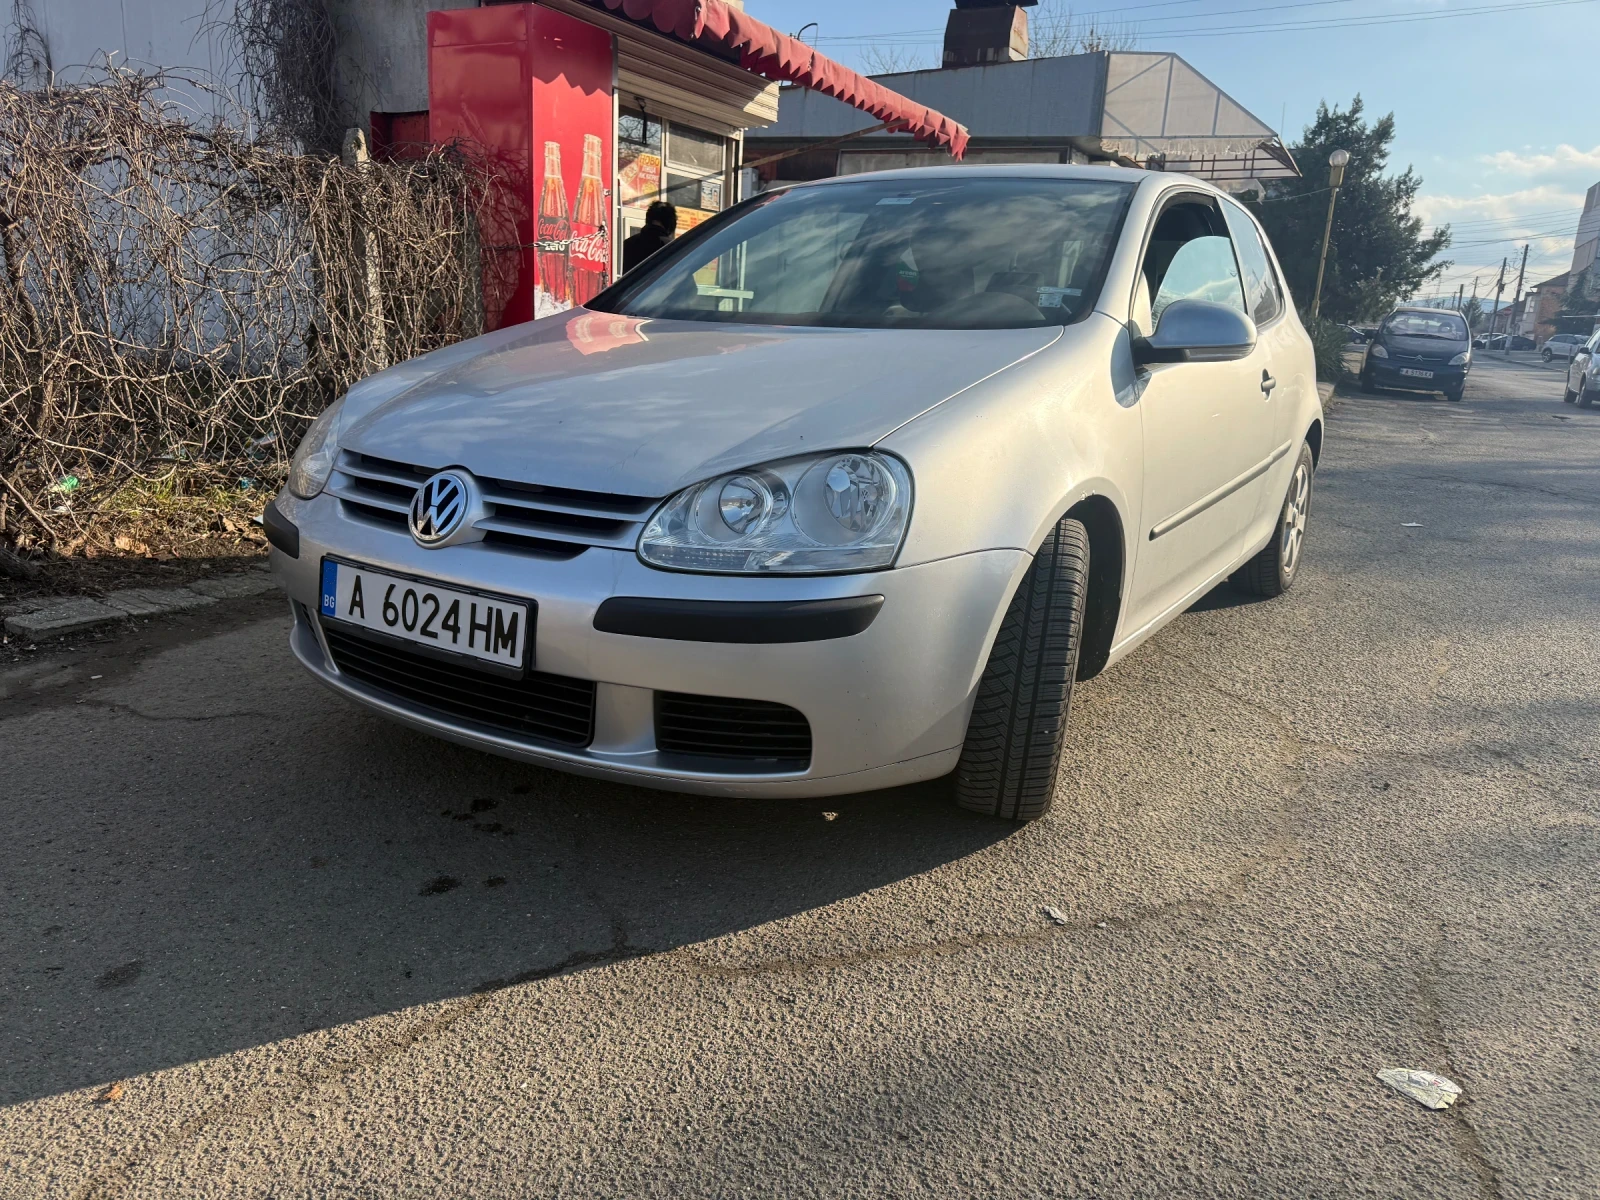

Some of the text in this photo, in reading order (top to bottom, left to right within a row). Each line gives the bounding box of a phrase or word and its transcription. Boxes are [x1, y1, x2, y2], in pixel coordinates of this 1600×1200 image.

[640, 155, 660, 166] НОВО
[538, 219, 568, 240] Coca-Col
[569, 231, 606, 262] Coca-Col
[324, 594, 334, 608] BG
[348, 575, 365, 619] A
